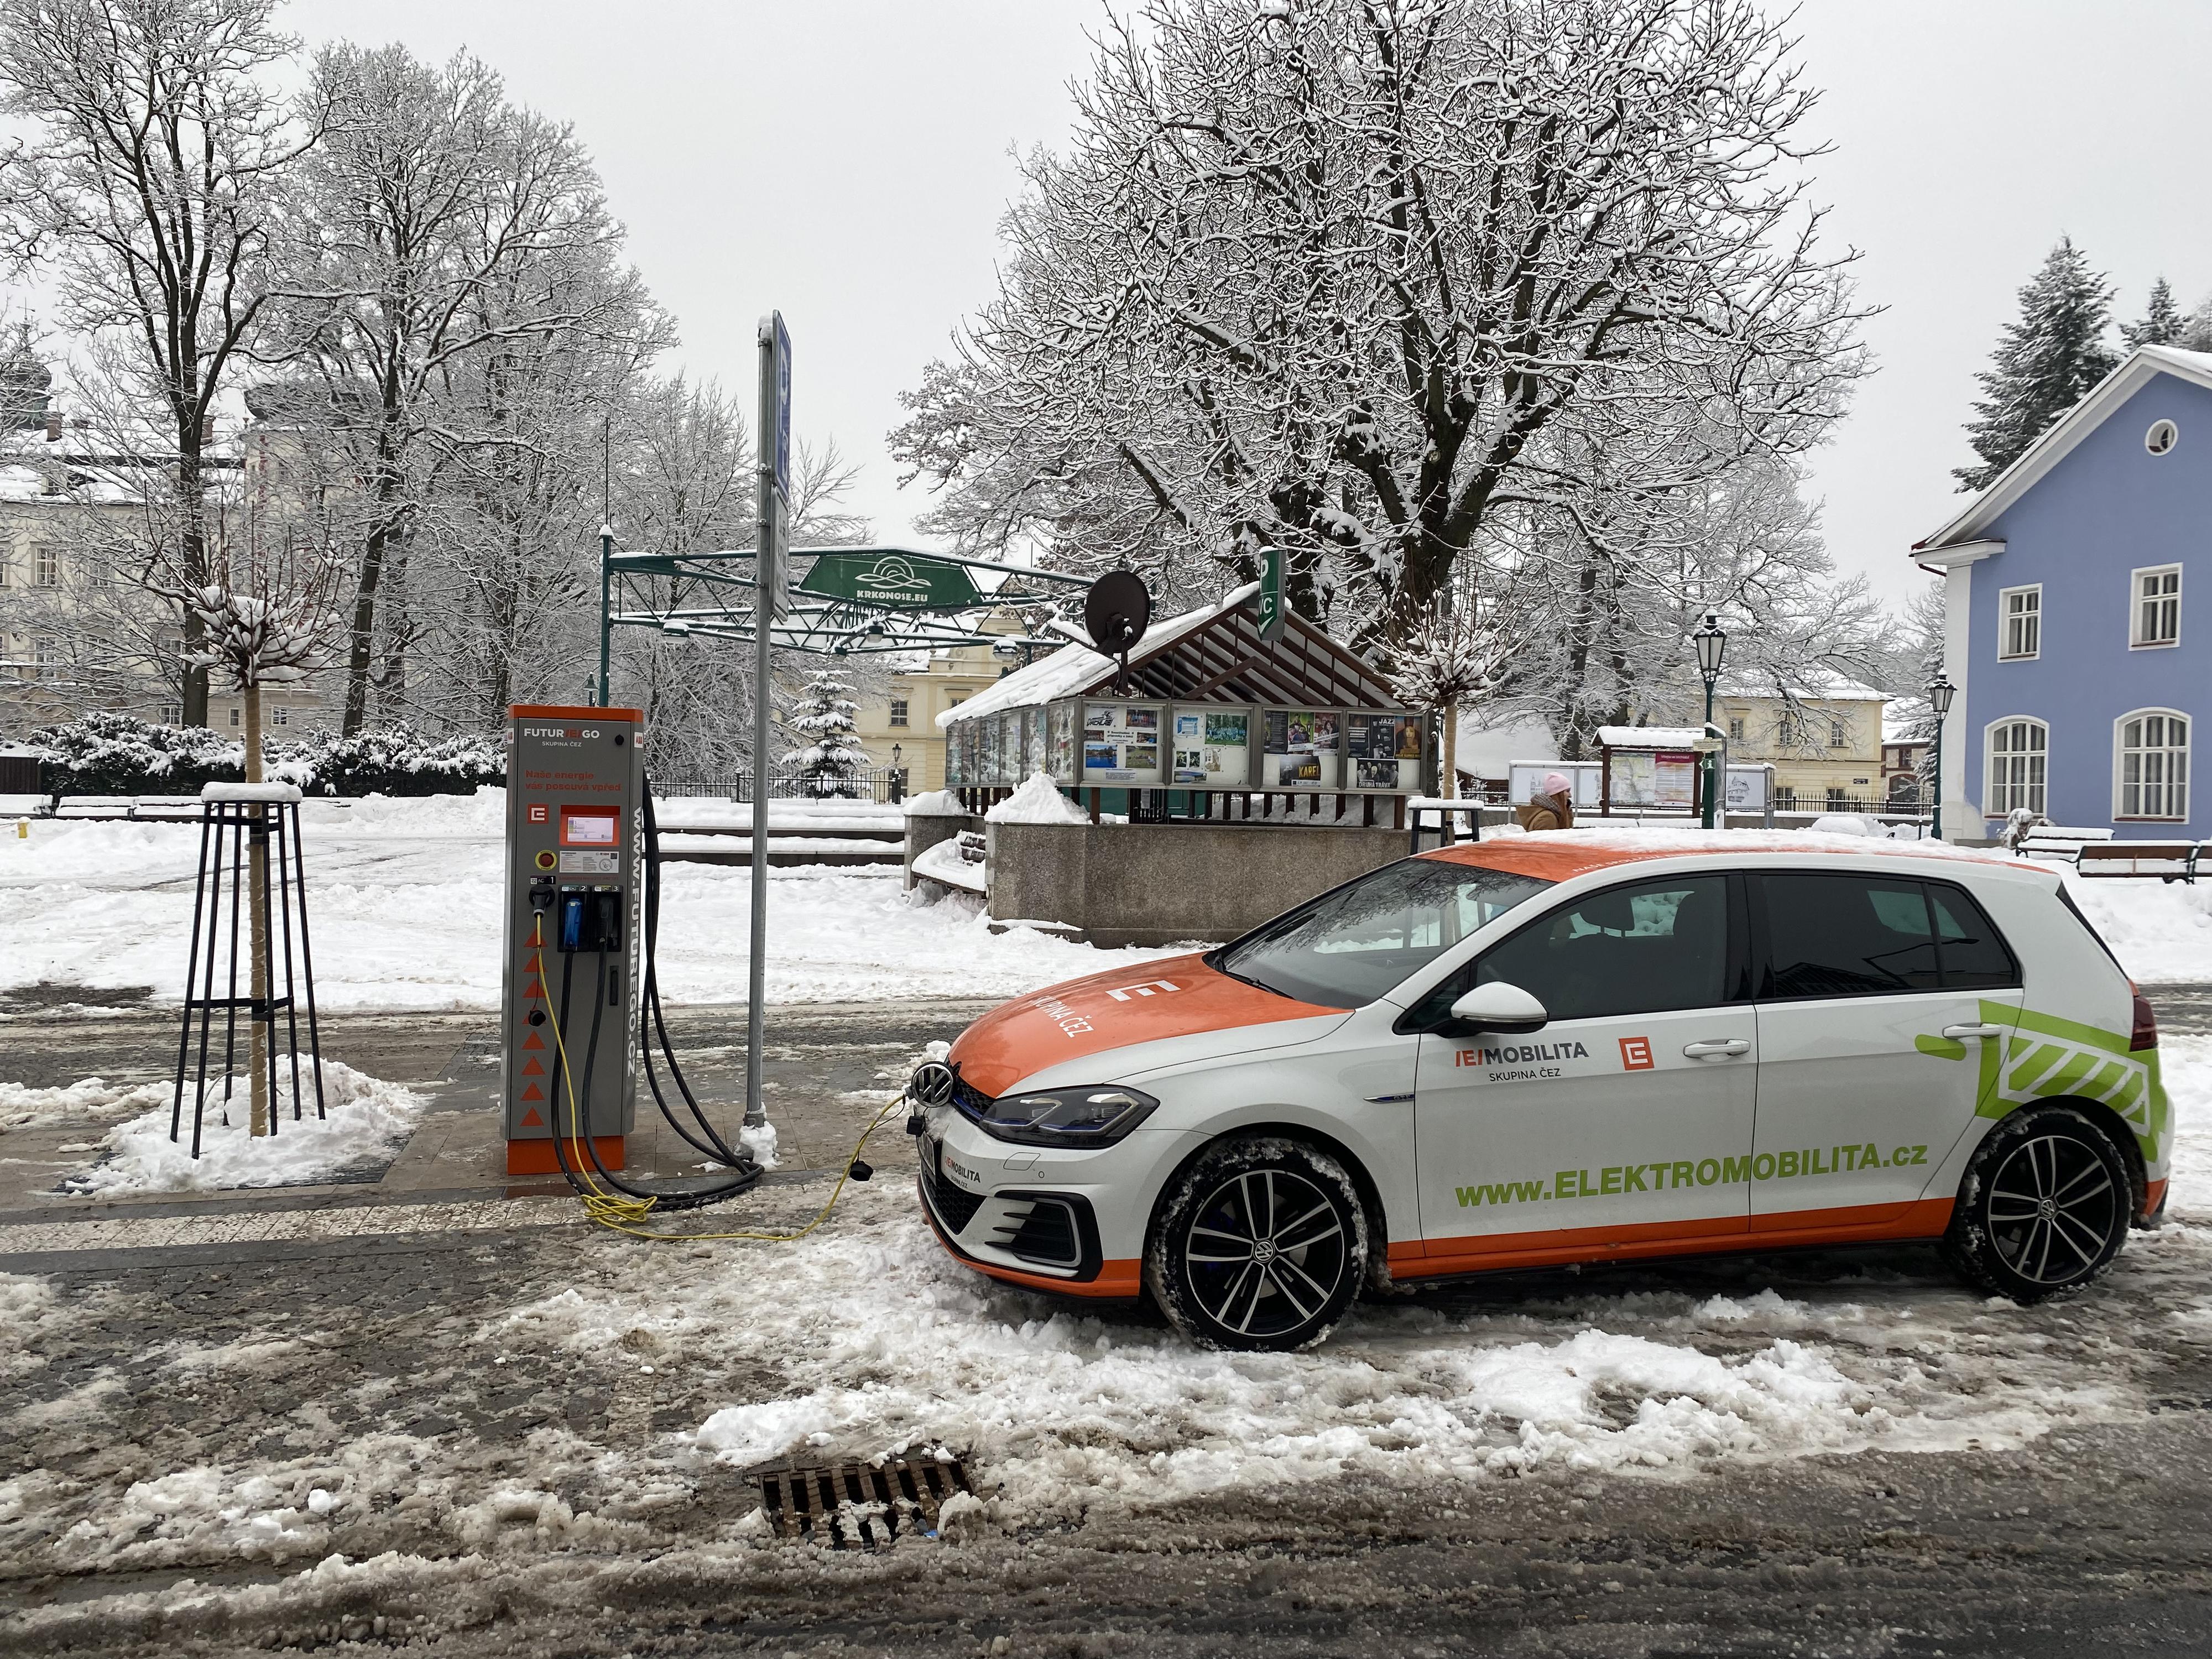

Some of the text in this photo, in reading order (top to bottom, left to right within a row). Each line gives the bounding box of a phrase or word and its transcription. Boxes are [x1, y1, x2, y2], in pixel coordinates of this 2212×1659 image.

[780, 342, 788, 434] P
[857, 589, 928, 602] KRKONOSE.EU
[628, 806, 641, 1077] WWW.FUTUREGO.CZ
[1059, 1015, 1094, 1038] ČEZ
[1489, 1068, 1561, 1082] SKUPINA ČEZ
[1455, 1143, 1928, 1208] www.ELEKTROMOBILITA.cz
